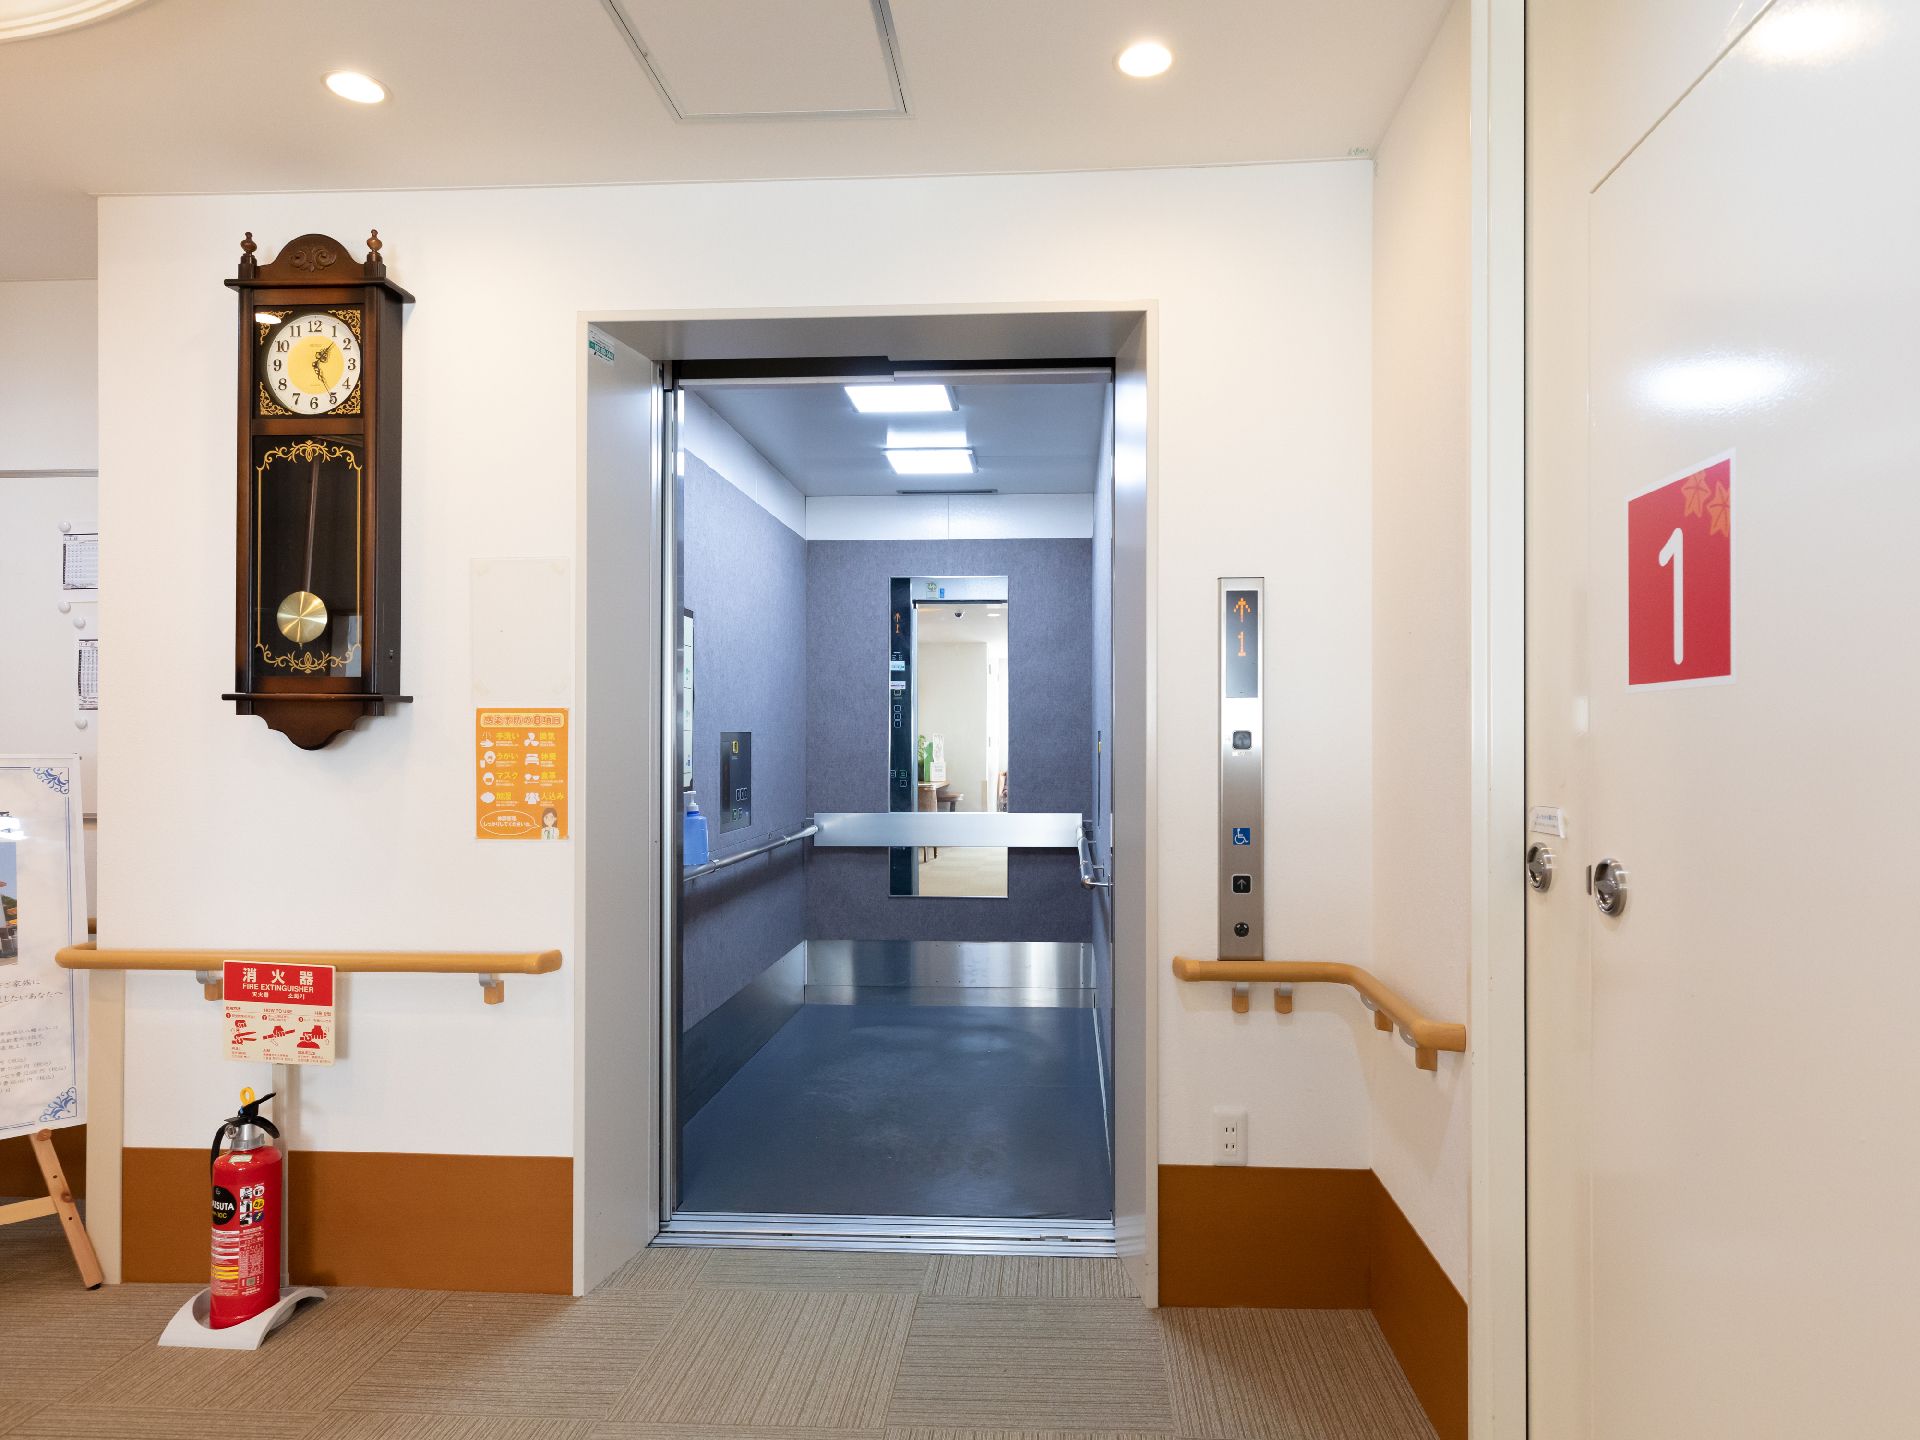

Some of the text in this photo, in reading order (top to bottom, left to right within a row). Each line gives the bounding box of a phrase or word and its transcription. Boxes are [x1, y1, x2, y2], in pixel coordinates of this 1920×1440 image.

[290, 325, 302, 337] 11
[308, 320, 322, 332] 12
[332, 326, 337, 337] 1
[276, 340, 290, 352] 10
[343, 338, 352, 350] 2
[273, 359, 282, 372] 9
[347, 357, 356, 370] 3
[278, 378, 287, 390] 8
[342, 377, 351, 390] 4
[292, 393, 301, 405] 7
[310, 397, 318, 409] 6
[329, 392, 338, 405] 5
[1658, 527, 1684, 665] 1
[1237, 631, 1247, 657] 1
[496, 752, 519, 761] うがい
[496, 771, 519, 780] マスク
[242, 968, 314, 986] 消火器
[260, 984, 314, 993] EXTINGUISHER
